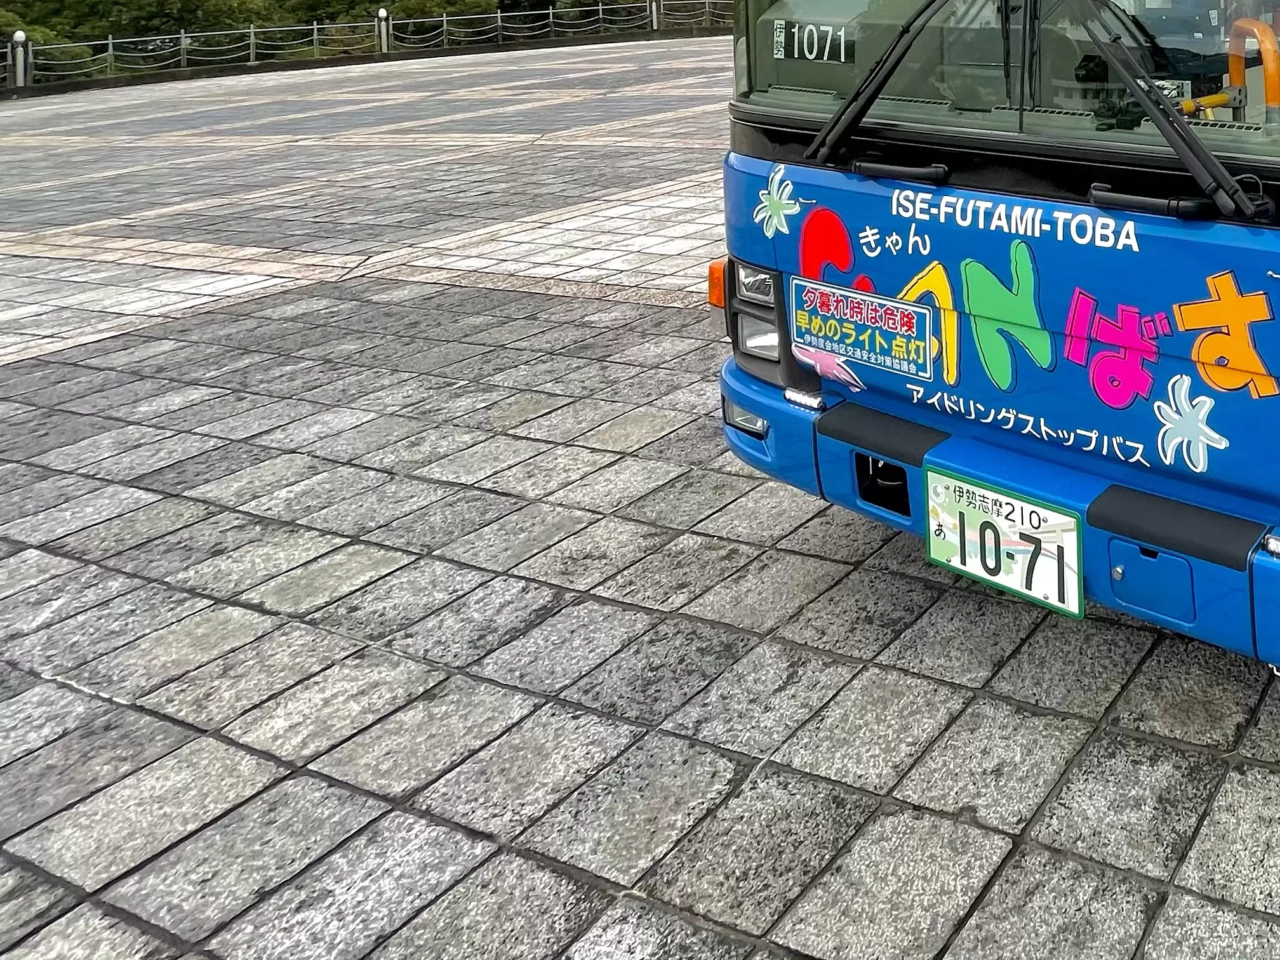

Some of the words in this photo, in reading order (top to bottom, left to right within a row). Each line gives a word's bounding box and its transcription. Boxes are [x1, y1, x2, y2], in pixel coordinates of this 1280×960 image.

[791, 24, 846, 62] 1071
[859, 223, 931, 257] きゃん
[892, 189, 1140, 252] ISE-FUTAMI-TOBA
[802, 286, 917, 337] 夕暮れ時は危険
[906, 383, 1152, 468] アイドリングストップバス
[934, 522, 946, 540] あ
[959, 511, 1065, 604] 10-71
